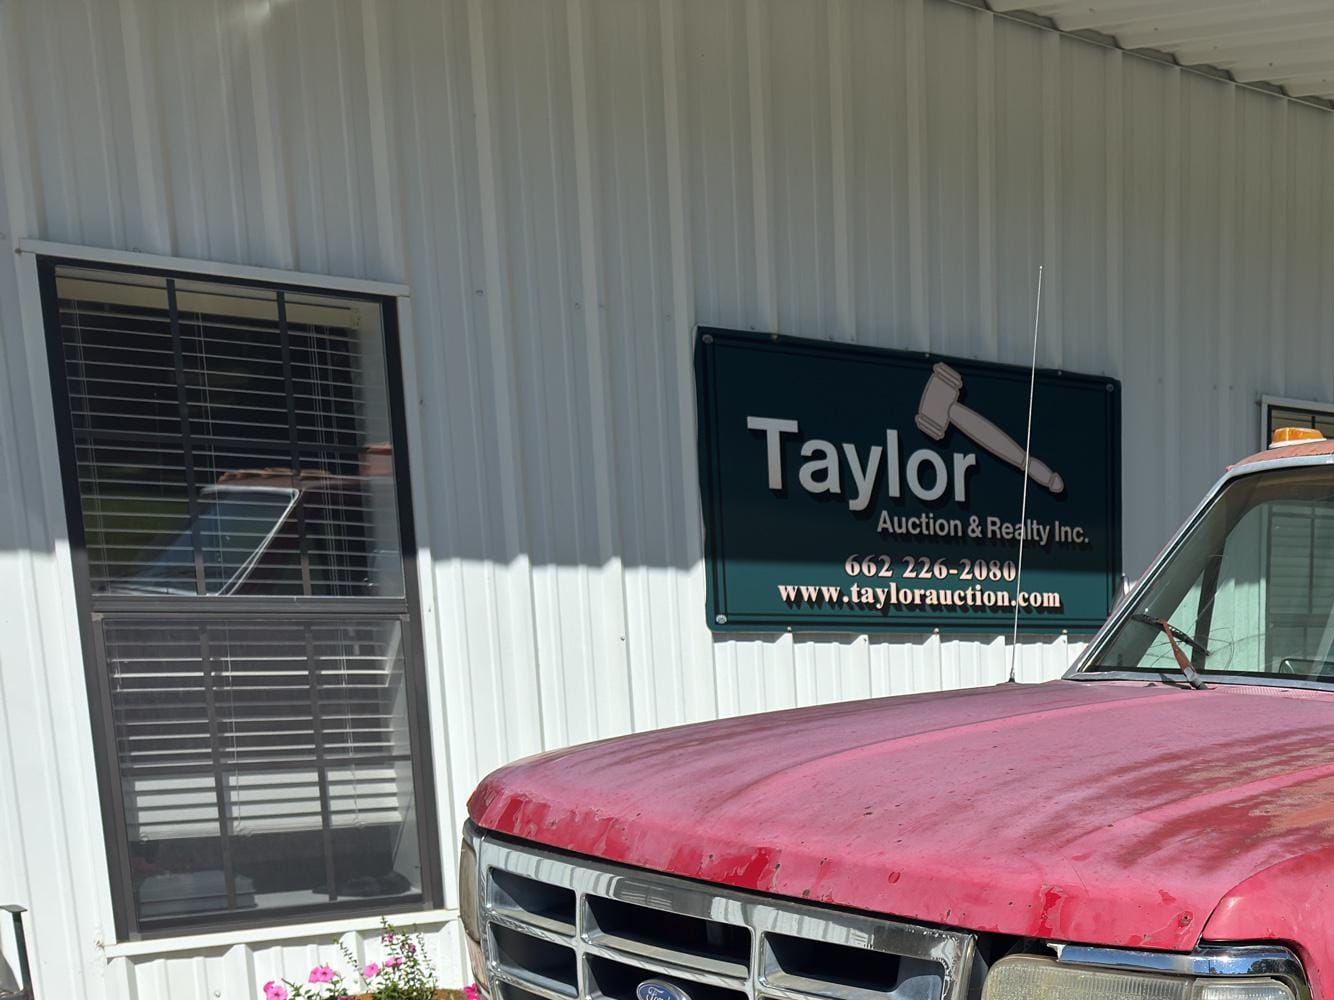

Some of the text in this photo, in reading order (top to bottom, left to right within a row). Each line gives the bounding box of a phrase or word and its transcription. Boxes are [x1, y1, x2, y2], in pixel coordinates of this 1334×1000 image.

[746, 415, 976, 511] Taylor
[876, 510, 1090, 545] Auction & Realty Inc.
[845, 553, 1017, 581] 662 226-2080
[777, 582, 1061, 609] www.taylorauction.com
